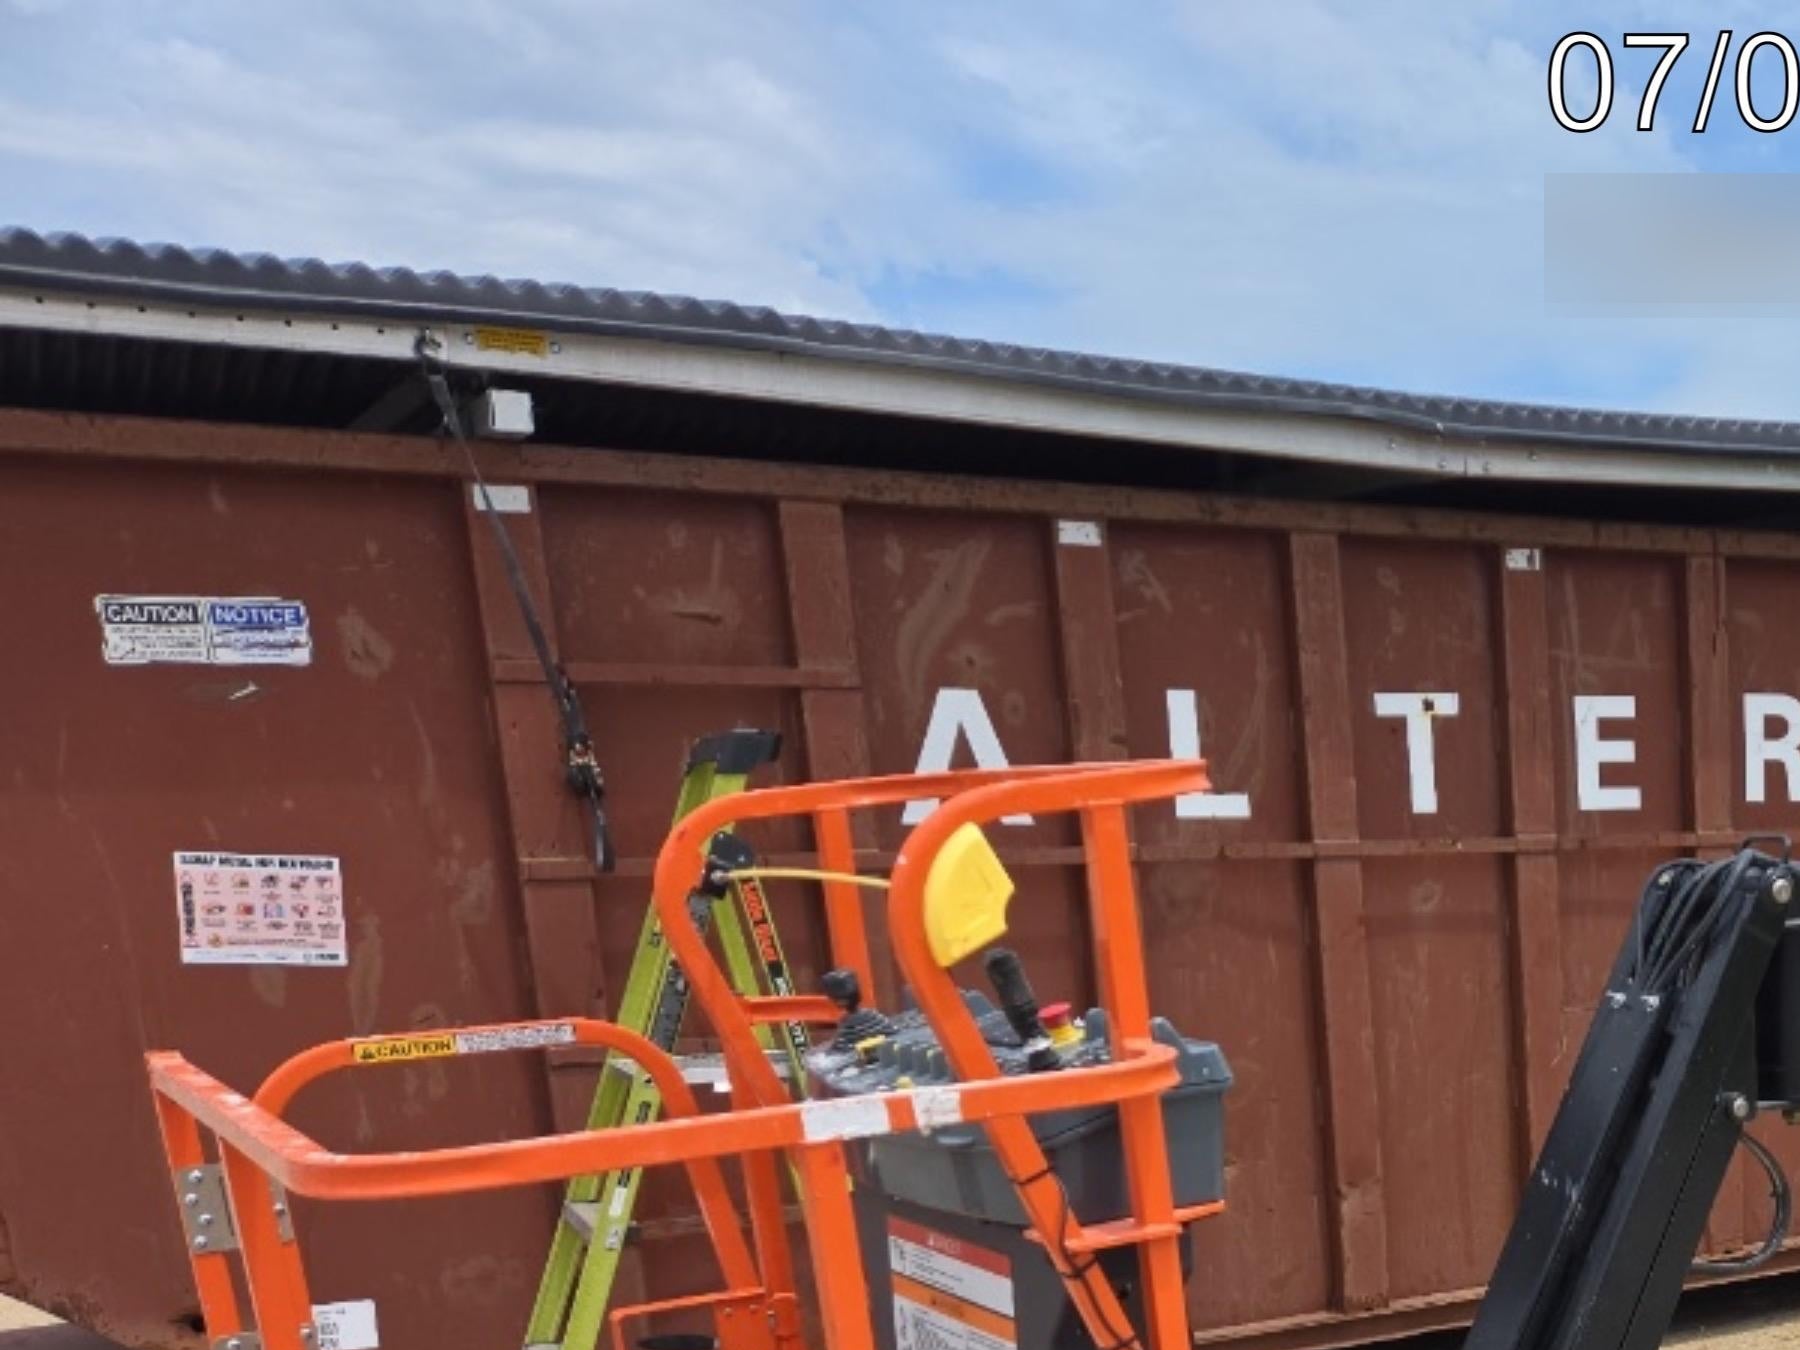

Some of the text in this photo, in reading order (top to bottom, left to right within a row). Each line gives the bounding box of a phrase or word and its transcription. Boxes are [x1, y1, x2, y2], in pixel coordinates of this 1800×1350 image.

[106, 604, 194, 623] CAUTION
[214, 607, 299, 625] NOTICE
[376, 1037, 452, 1058] CAUTION
